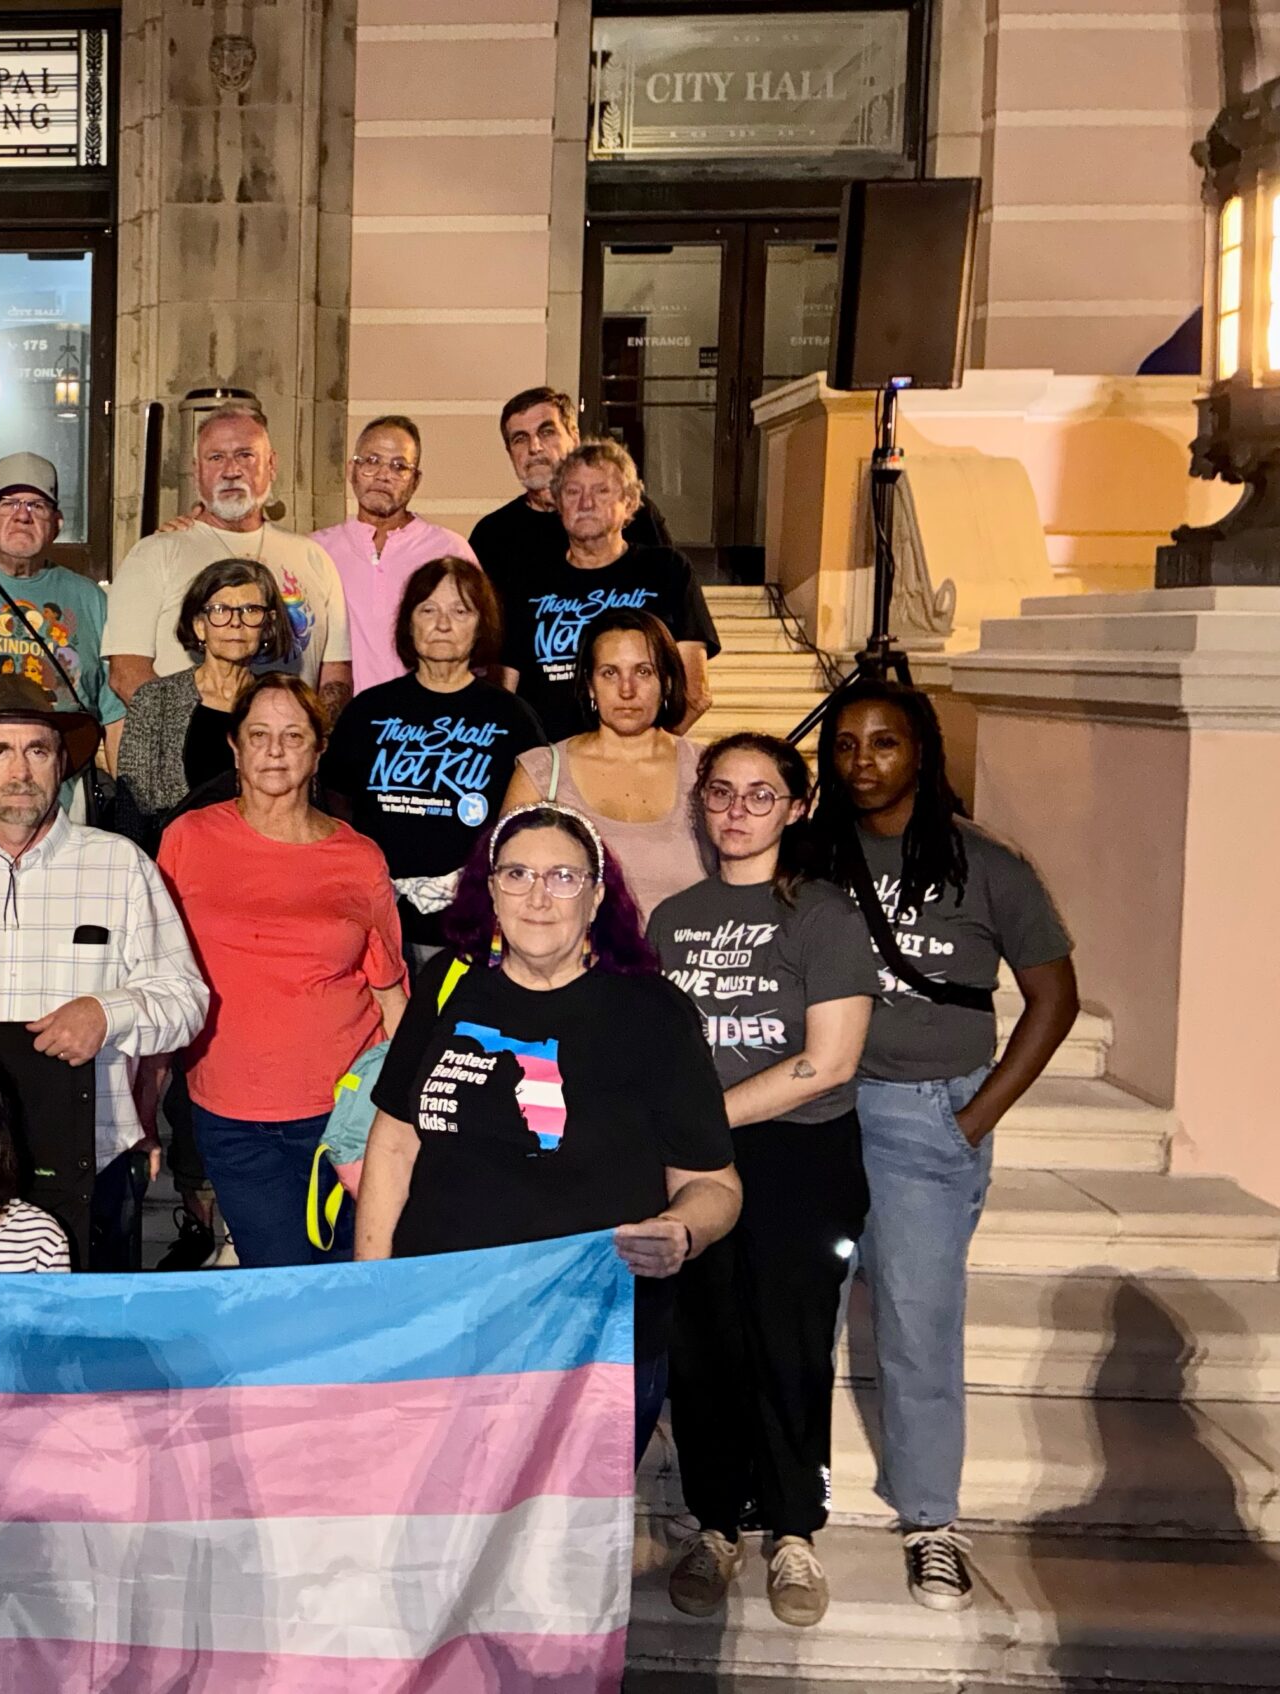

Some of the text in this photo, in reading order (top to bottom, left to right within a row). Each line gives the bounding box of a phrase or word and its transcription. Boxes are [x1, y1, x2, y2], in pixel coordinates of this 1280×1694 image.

[646, 70, 735, 103] CITY
[23, 340, 48, 350] 175
[627, 336, 691, 347] ENTRANCE
[33, 368, 64, 378] ONLY
[529, 587, 658, 619] Thou Shalt
[371, 716, 508, 750] Thou Shalt
[674, 920, 779, 949] When HATE
[929, 937, 954, 955] be
[704, 952, 749, 967] LOUD
[662, 969, 779, 997] OVE MUST be
[440, 1050, 497, 1071] Protect
[430, 1064, 487, 1085] Believe
[423, 1078, 457, 1094] Love
[419, 1094, 458, 1113] Trans
[418, 1113, 447, 1131] Kids
